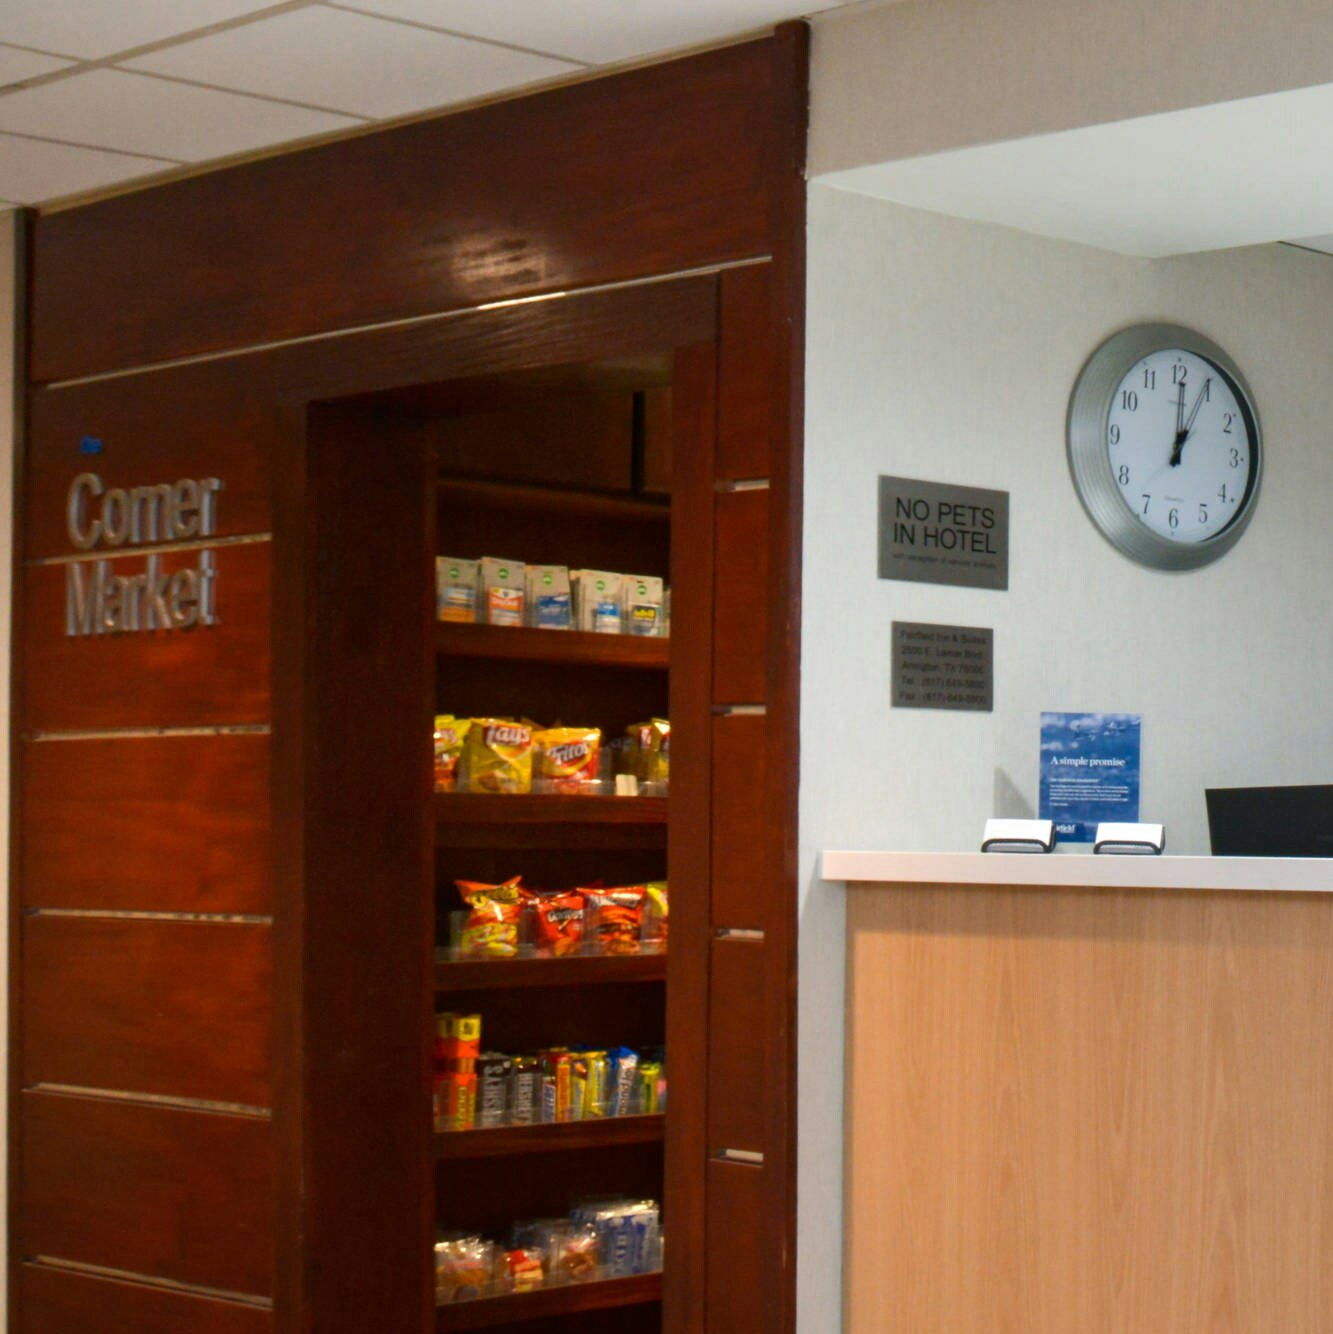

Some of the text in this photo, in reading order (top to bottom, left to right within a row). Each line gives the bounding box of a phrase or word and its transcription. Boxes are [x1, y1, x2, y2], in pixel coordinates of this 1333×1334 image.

[1144, 368, 1156, 390] 11
[1171, 364, 1187, 385] 12
[1121, 390, 1138, 412] 10
[1223, 413, 1232, 434] 2
[1110, 424, 1120, 445] 9
[1229, 448, 1239, 468] 3
[1119, 465, 1130, 486] 8
[1217, 483, 1227, 503] 4
[67, 472, 222, 549] Corner
[896, 497, 995, 529] NO PETS
[1142, 494, 1151, 514] 7
[1199, 503, 1208, 523] 5
[1168, 509, 1179, 529] 6
[894, 522, 997, 554] IN HOTEL
[65, 550, 219, 637] Market
[1050, 756, 1126, 768] A simple promise
